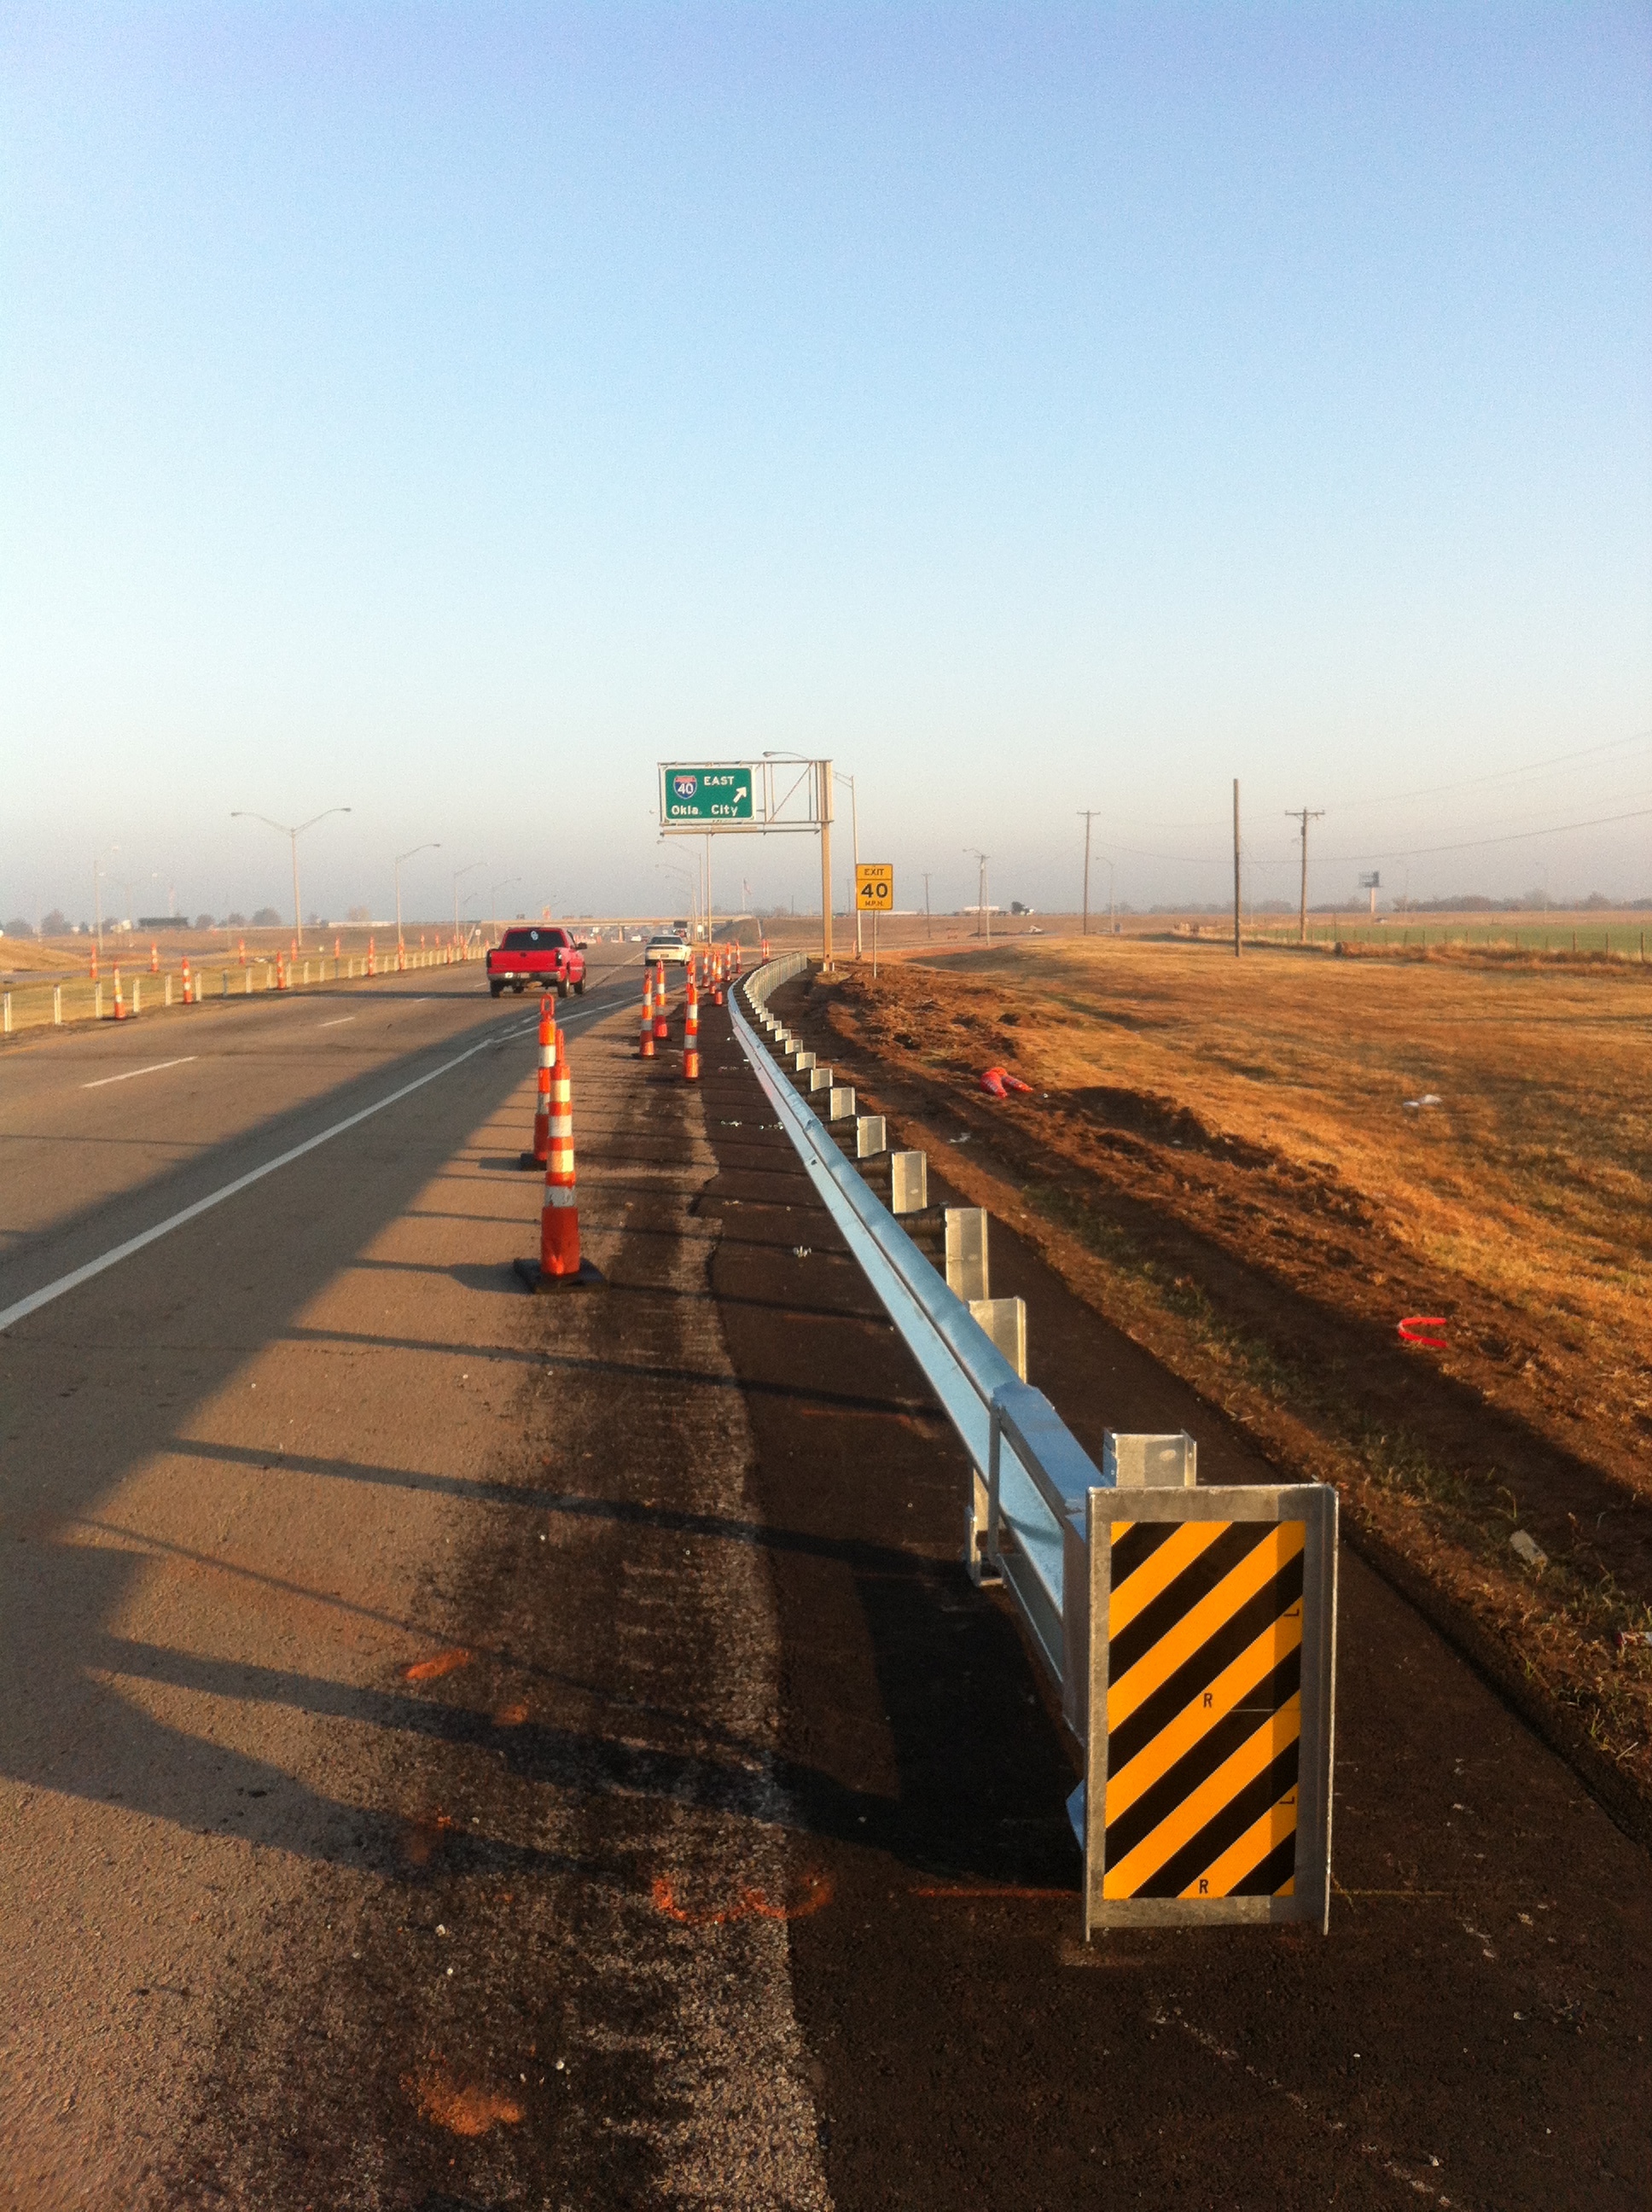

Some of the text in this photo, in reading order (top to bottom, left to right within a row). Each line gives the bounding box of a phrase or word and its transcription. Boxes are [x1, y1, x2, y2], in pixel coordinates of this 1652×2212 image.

[704, 776, 734, 785] EAST
[678, 783, 693, 794] 40
[711, 805, 737, 816] City
[861, 882, 887, 898] 40
[1203, 1693, 1213, 1708] R
[1199, 1879, 1208, 1894] R
